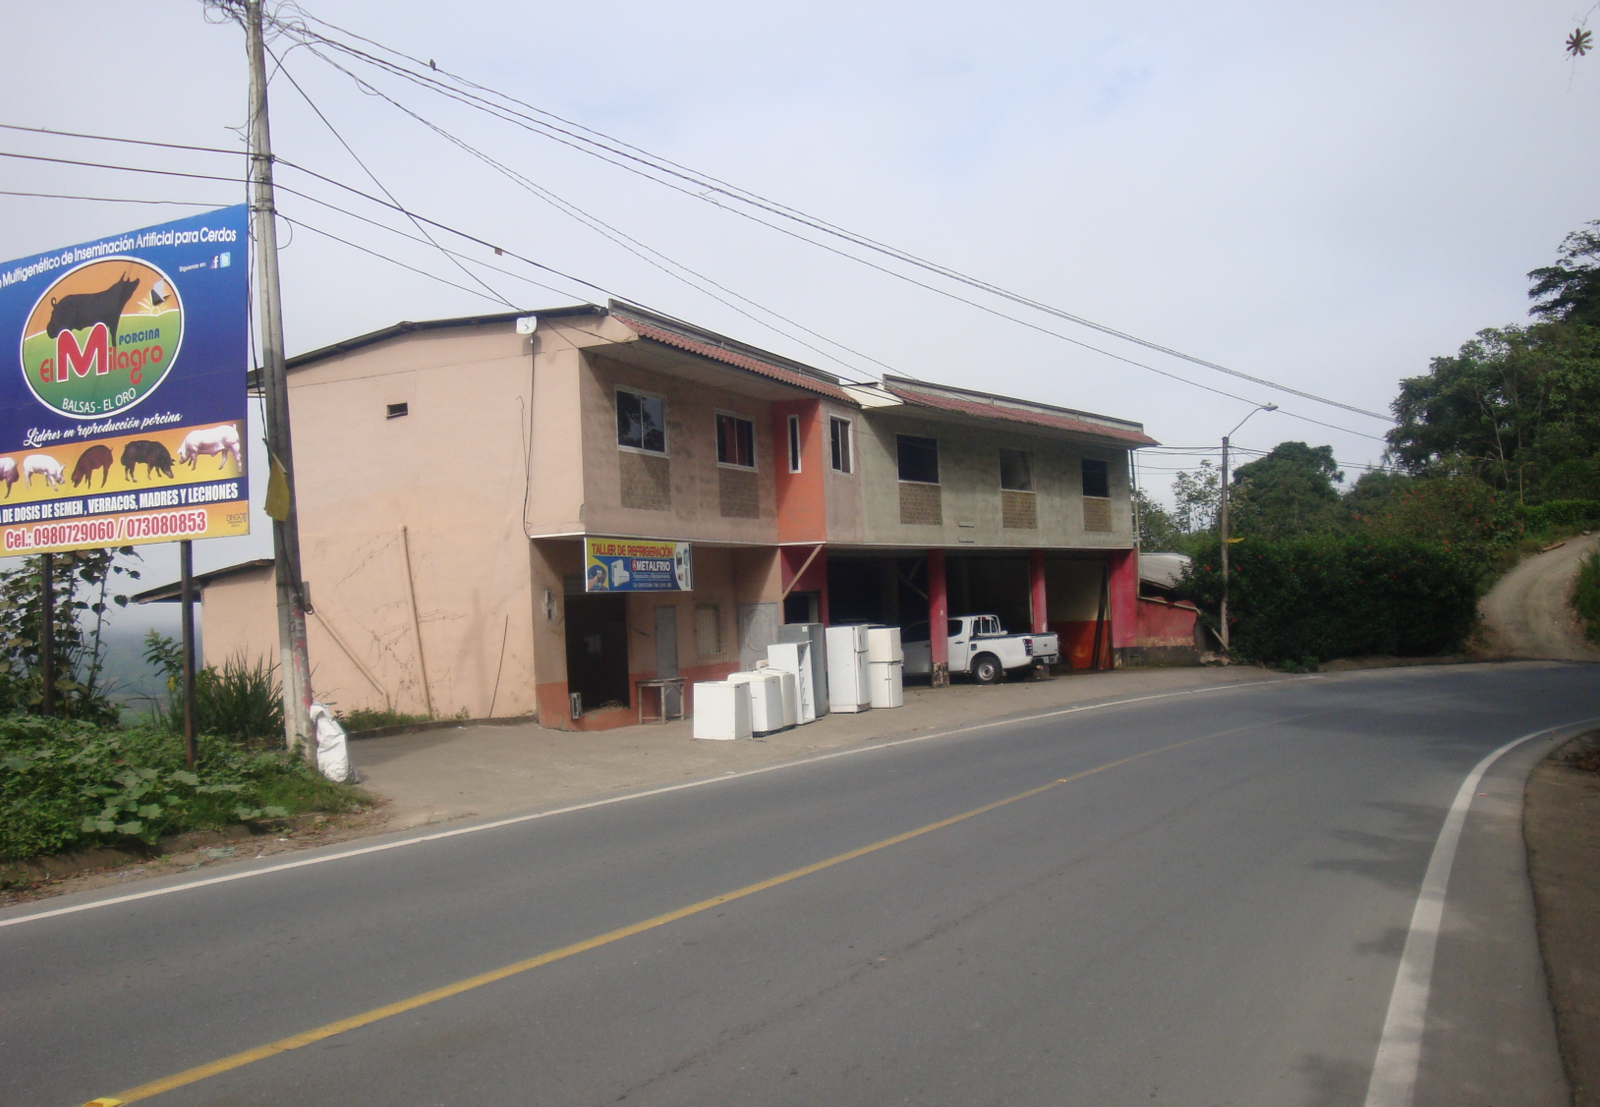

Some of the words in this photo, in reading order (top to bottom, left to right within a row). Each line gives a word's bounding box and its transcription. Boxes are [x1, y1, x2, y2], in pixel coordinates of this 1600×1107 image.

[2, 255, 60, 288] Multigenético
[61, 250, 74, 266] de
[74, 236, 135, 261] Inseminación
[135, 230, 174, 248] Artificial
[175, 232, 199, 247] para
[200, 226, 237, 243] Cerdos
[118, 327, 160, 346] PORCINA
[39, 359, 54, 384] El
[56, 321, 163, 386] Milagro
[62, 397, 96, 414] BALSAS
[103, 396, 115, 412] EL
[115, 387, 137, 407] ORO
[63, 429, 76, 439] en
[77, 418, 141, 439] reproducción
[141, 412, 184, 431] porcina
[3, 508, 14, 523] DE
[14, 505, 41, 522] DOSIS
[41, 504, 53, 519] DE
[53, 500, 83, 517] SEMEN
[87, 495, 138, 514] VERRACOS,
[139, 489, 179, 508] MADRES
[180, 488, 187, 503] Y
[188, 482, 238, 502] LECHONES
[33, 520, 114, 546] 0980729060
[117, 519, 124, 539] /
[126, 511, 206, 537] 073080853
[591, 543, 616, 556] TALLER
[617, 545, 626, 556] DE
[627, 544, 674, 558] REFRIGERACIÓN
[636, 560, 671, 572] METALFRIO
